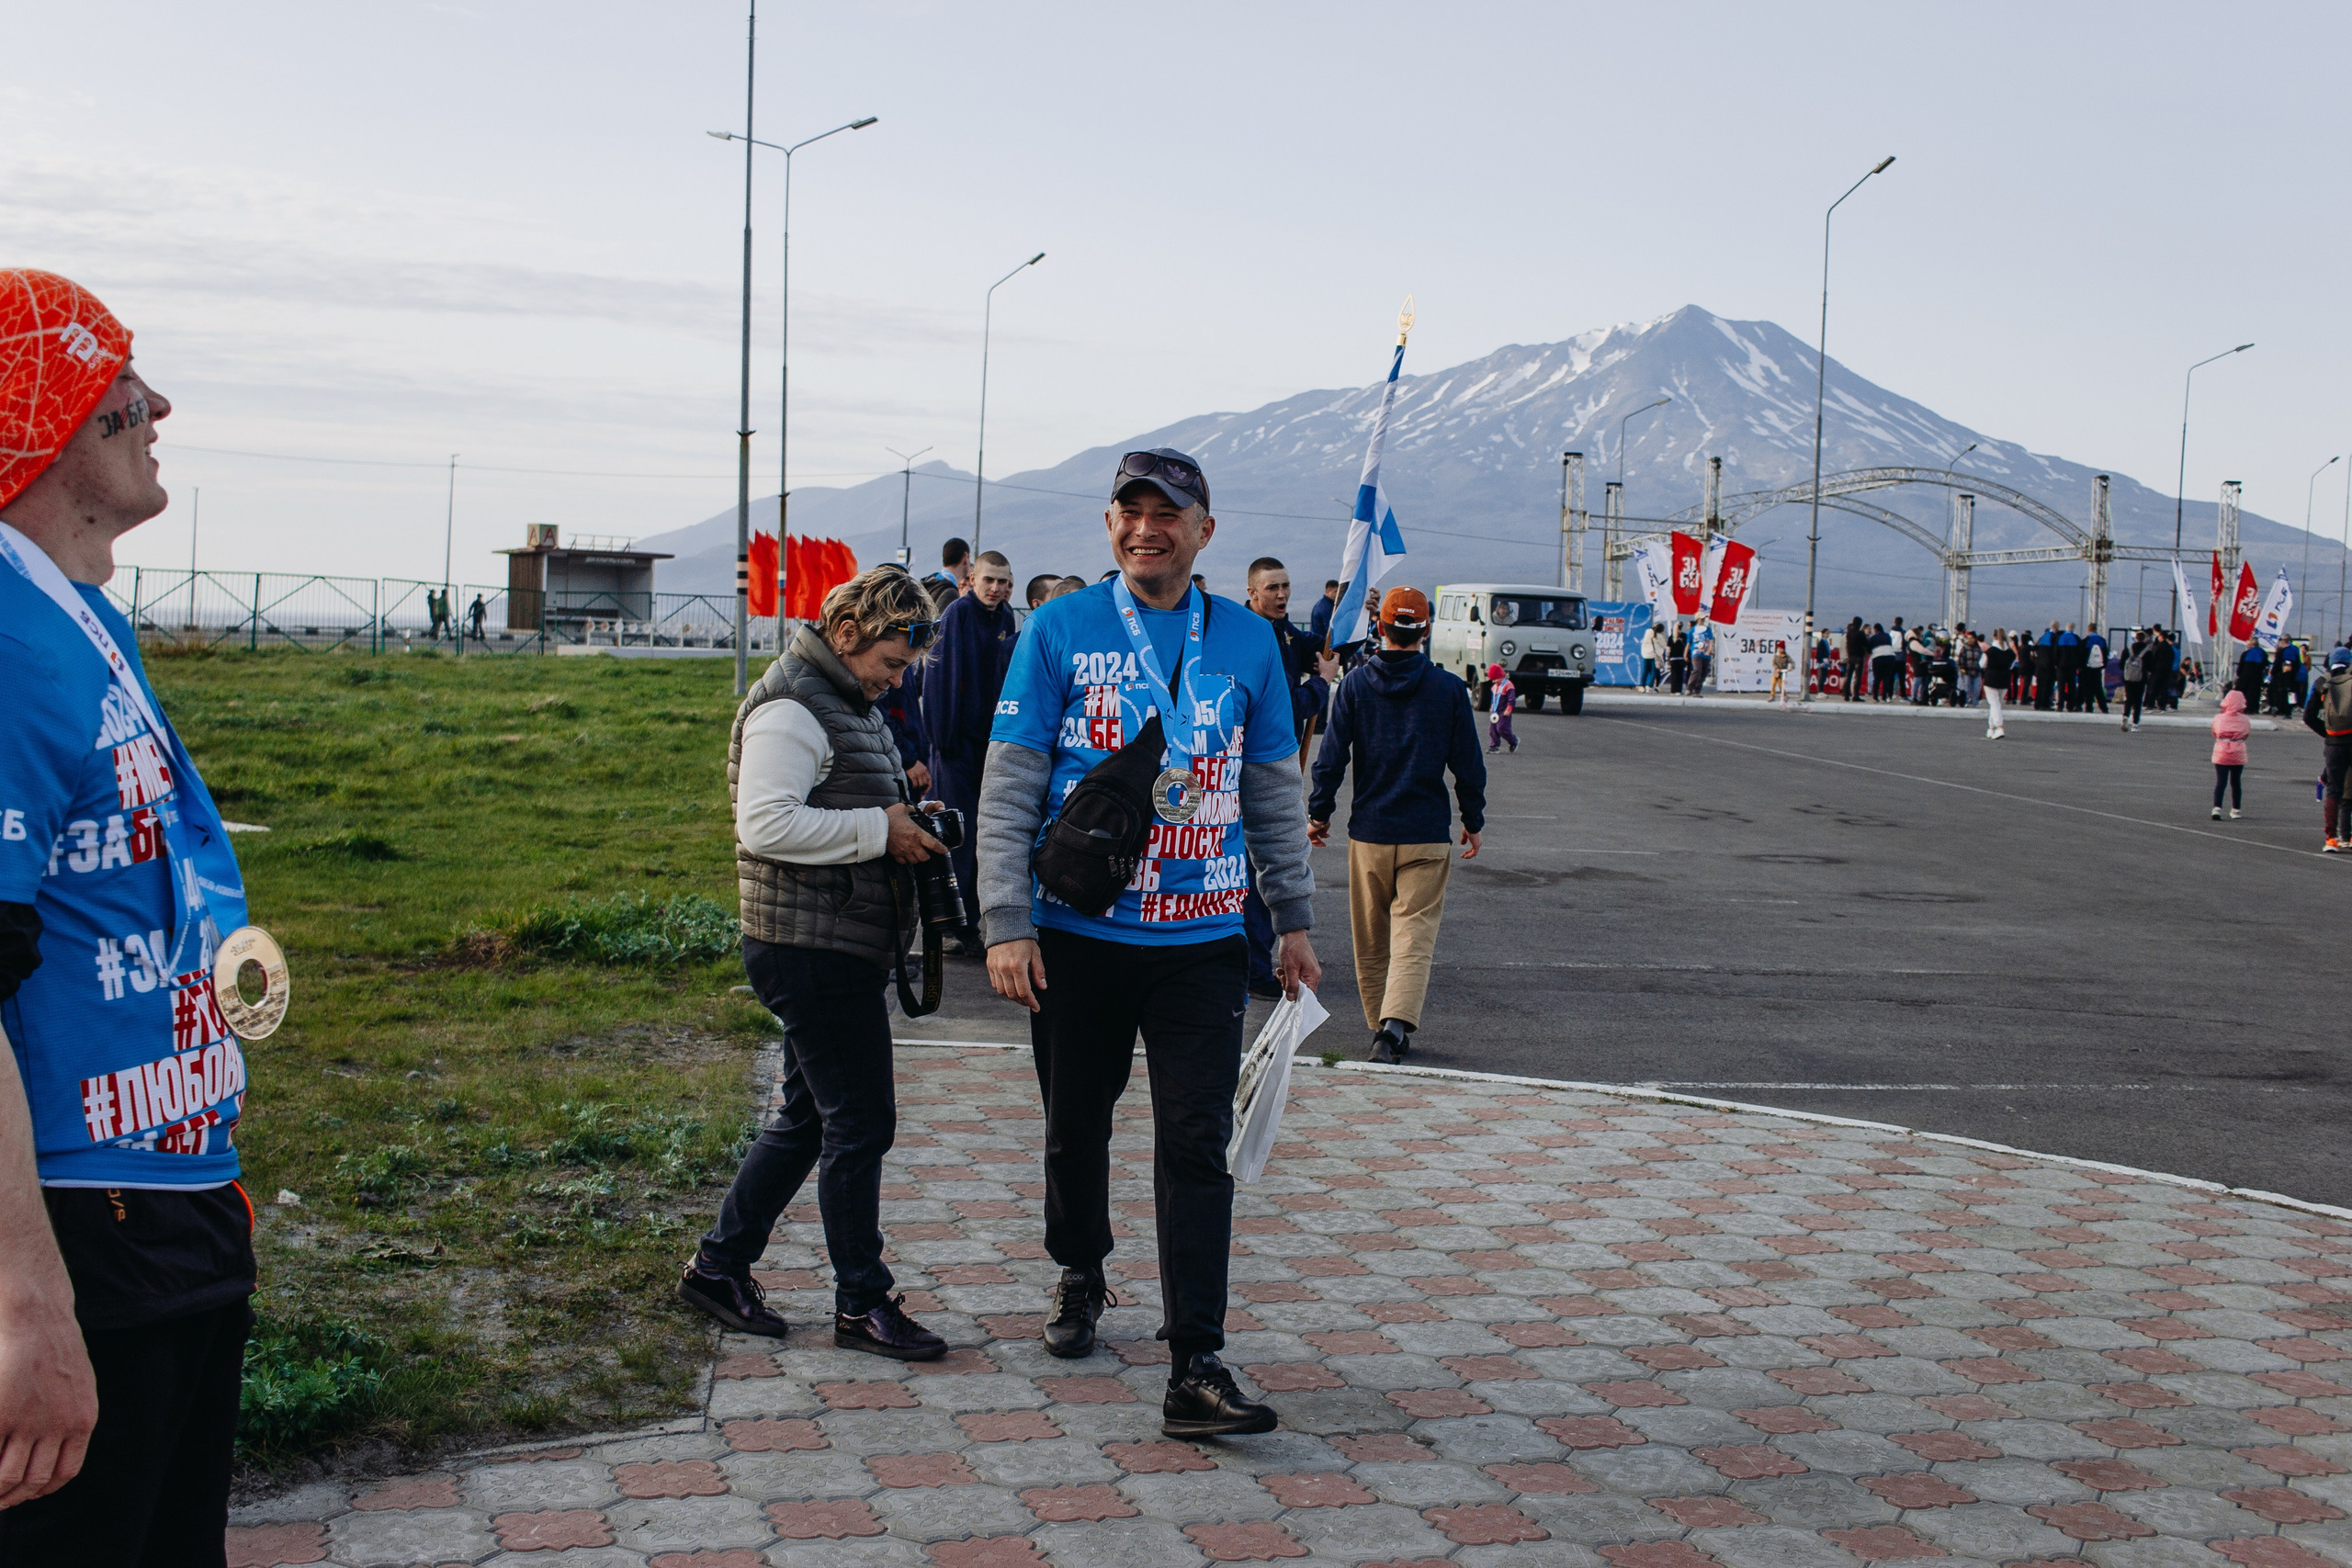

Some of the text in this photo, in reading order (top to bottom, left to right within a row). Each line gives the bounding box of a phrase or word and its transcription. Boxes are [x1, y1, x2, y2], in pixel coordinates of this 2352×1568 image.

[1127, 616, 1141, 637] ПСБ
[1192, 612, 1201, 630] ПСБ
[1597, 632, 1624, 649] 2024
[1072, 651, 1139, 685] 2024
[1193, 757, 1227, 791] БЕГ
[1141, 825, 1227, 860] РДОСТЬ
[1204, 854, 1248, 891] 2024
